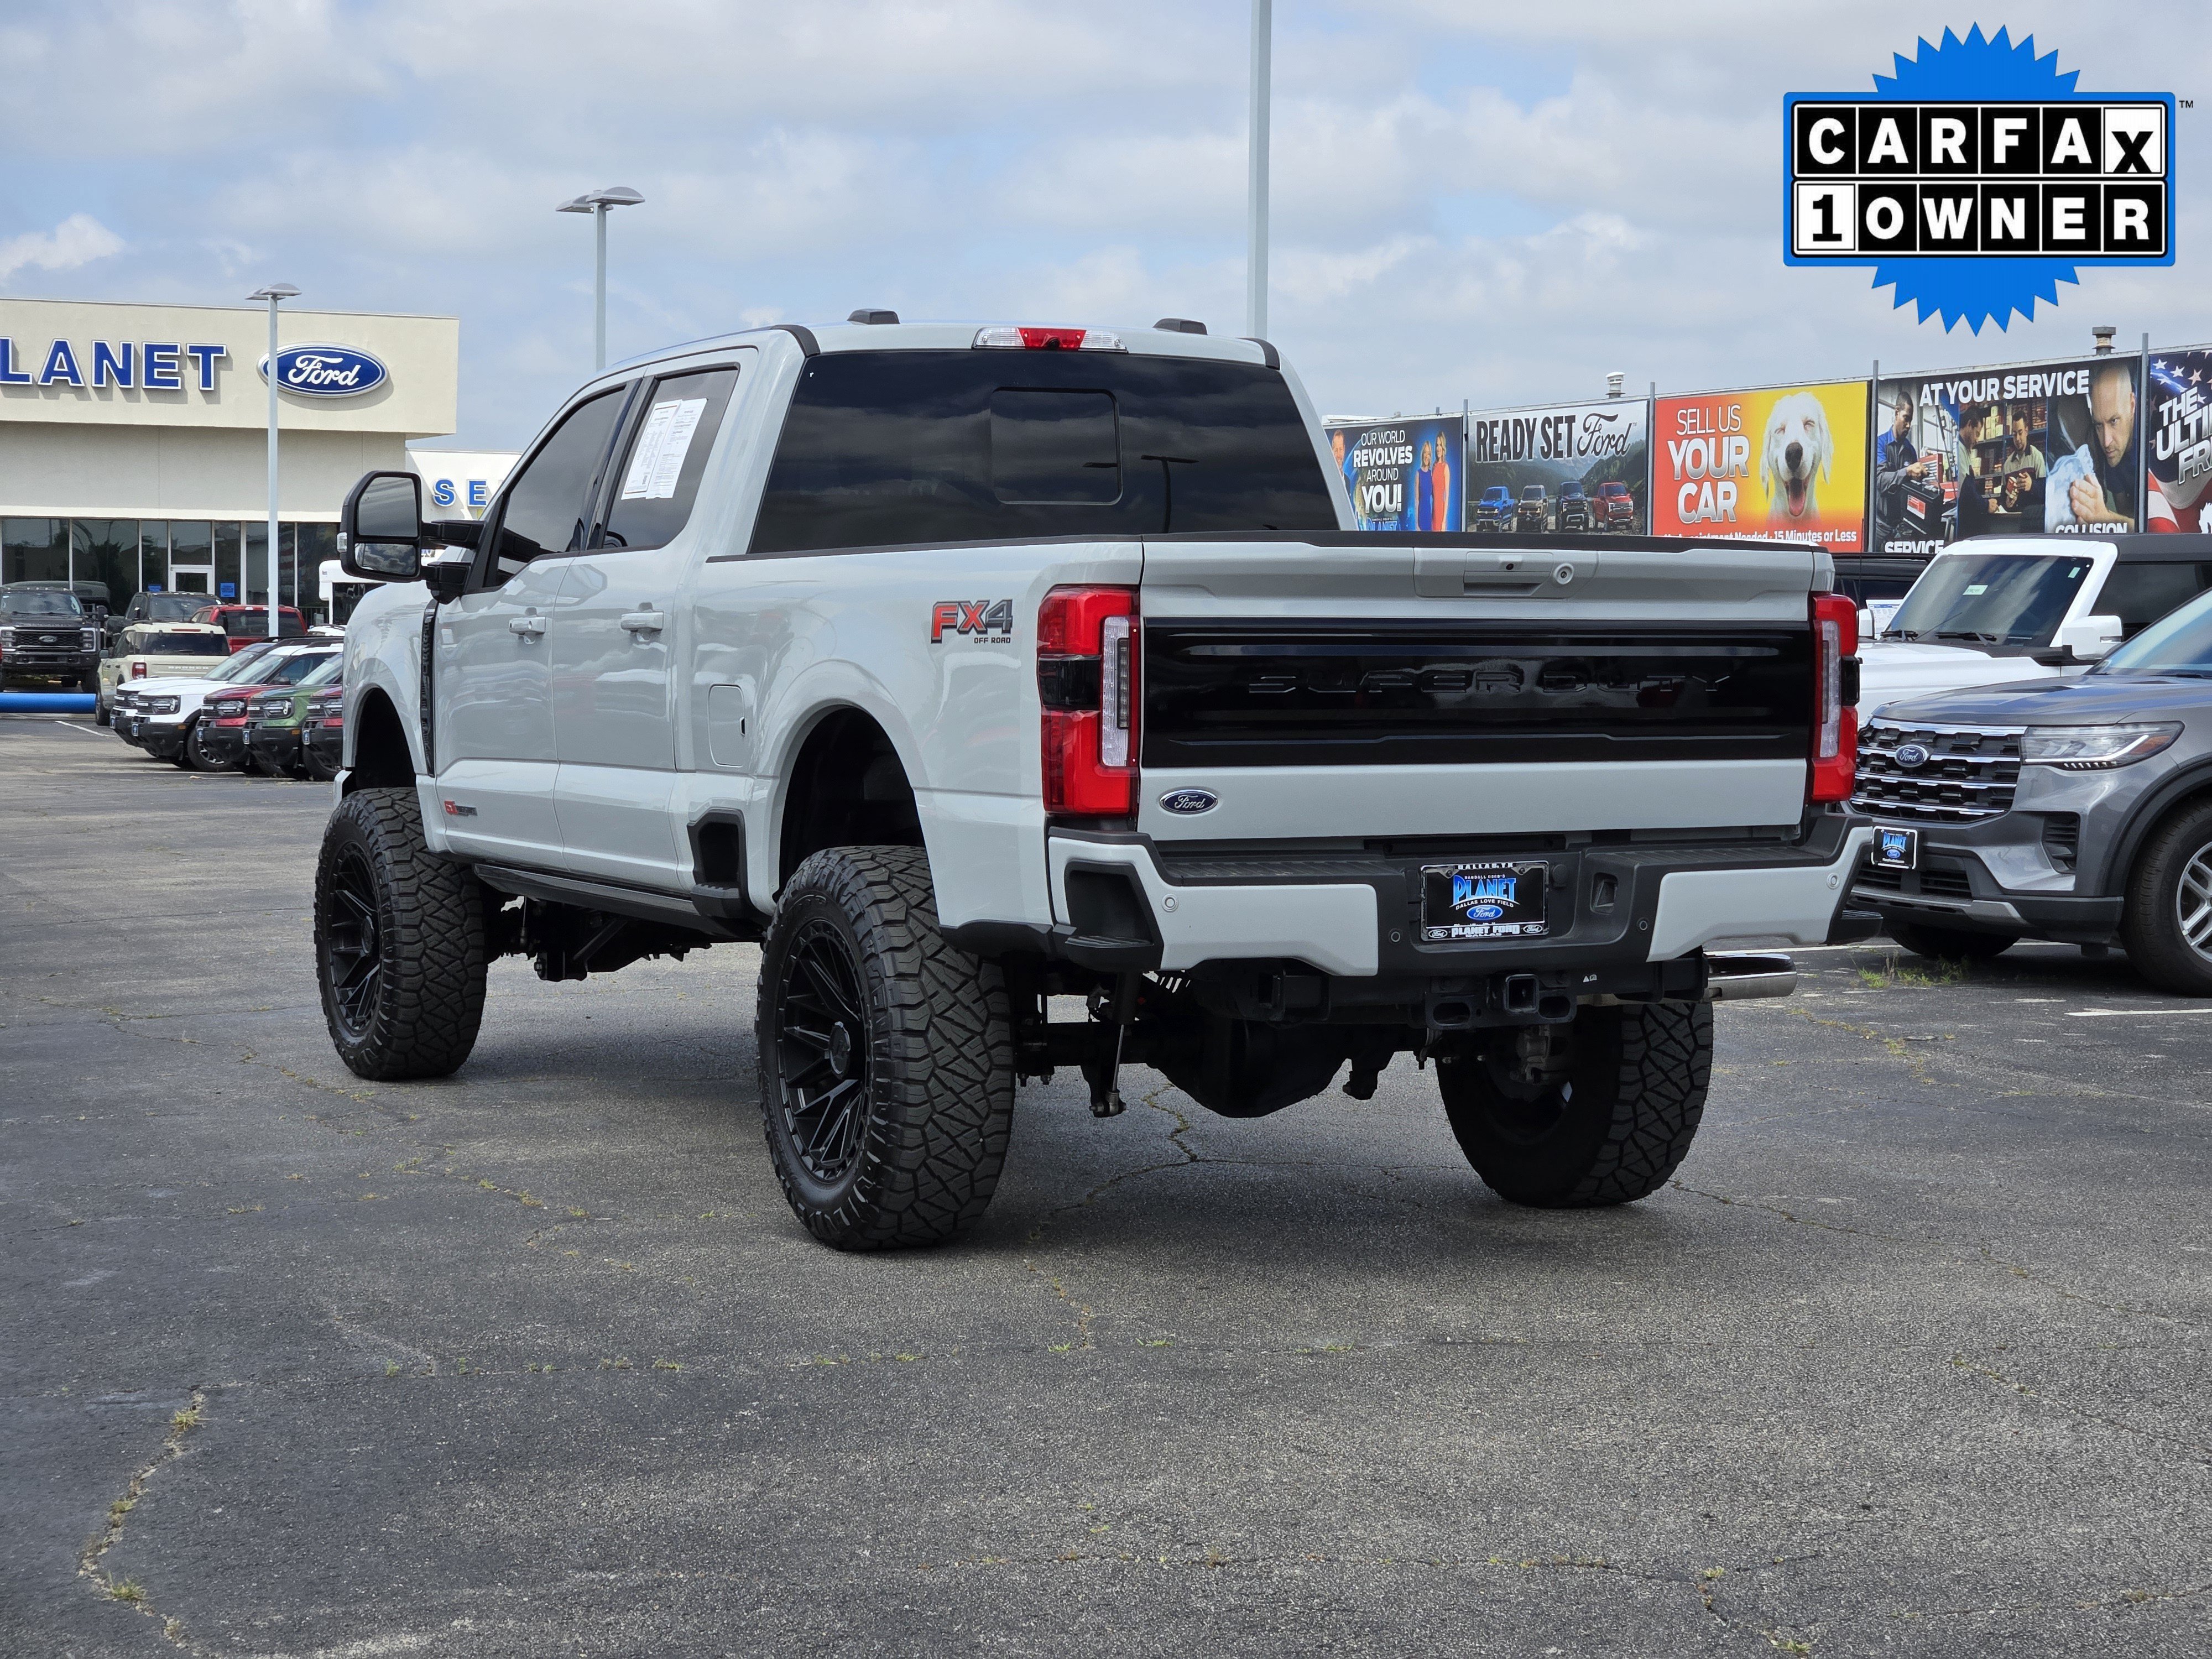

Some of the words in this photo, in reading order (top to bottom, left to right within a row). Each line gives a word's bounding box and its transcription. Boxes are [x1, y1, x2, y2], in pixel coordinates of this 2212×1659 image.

[0, 337, 227, 390] LANET
[287, 354, 361, 387] Ford
[1919, 382, 1943, 406] AT
[1945, 377, 2000, 405] YOUR
[2003, 369, 2089, 400] SERVICE
[1676, 408, 1715, 435] SELL
[1718, 404, 1741, 432] US
[2159, 387, 2198, 426] THE
[1361, 432, 1377, 446] OUR
[1378, 430, 1405, 445] WORLD
[1476, 417, 1537, 462] READY
[1540, 415, 1576, 460] SET
[1577, 413, 1632, 457] Ford
[2156, 403, 2212, 461] ULTI
[1353, 445, 1413, 467] REVOLVES
[1667, 435, 1750, 480] YOUR
[1366, 468, 1399, 482] AROUND
[1361, 483, 1402, 513] YOU!
[1678, 481, 1738, 524] CAR
[1785, 530, 1822, 542] Minutes
[1823, 531, 1834, 542] or
[1835, 529, 1857, 542] Less
[931, 598, 1013, 644] FX4
[1900, 748, 1919, 761] Ford
[1174, 795, 1206, 808] Ford
[1453, 875, 1516, 904] PLANET
[1455, 900, 1478, 910] DALLAS
[1498, 899, 1514, 907] FIELD
[1473, 907, 1495, 918] Ford
[1451, 926, 1490, 937] PLANET
[1493, 925, 1520, 935] FORD
